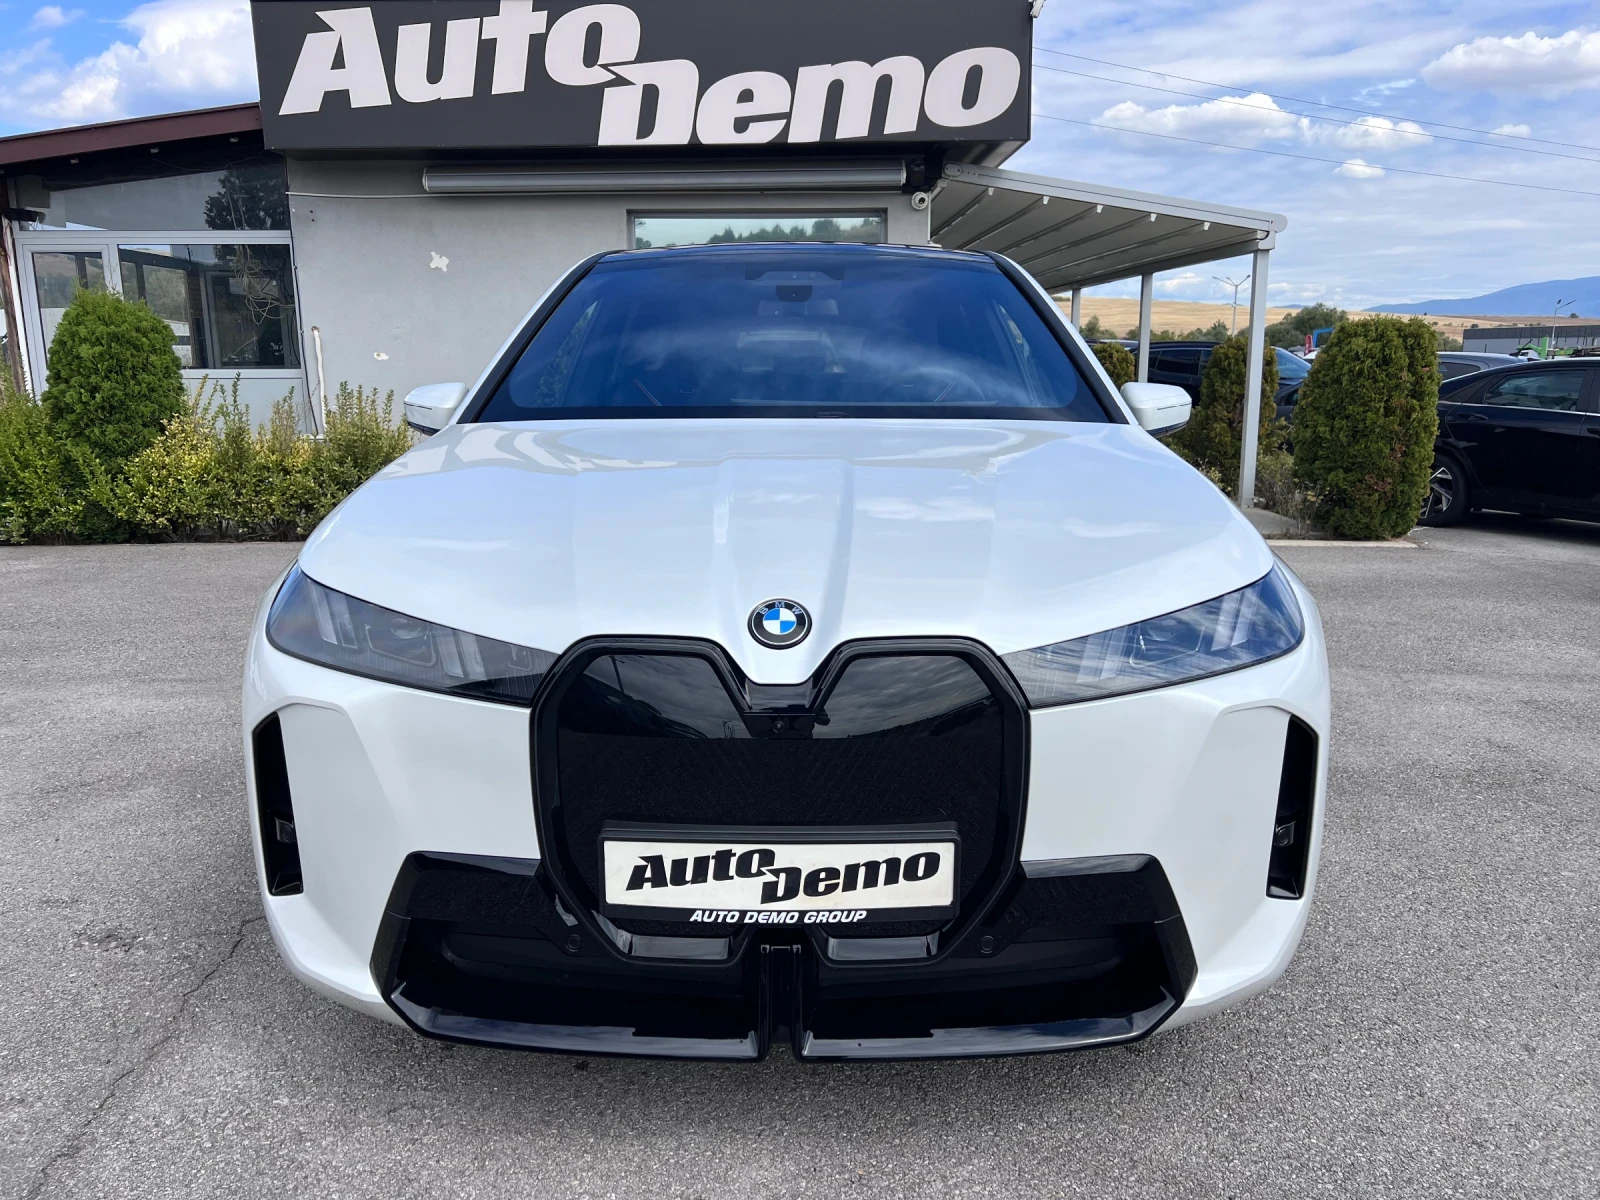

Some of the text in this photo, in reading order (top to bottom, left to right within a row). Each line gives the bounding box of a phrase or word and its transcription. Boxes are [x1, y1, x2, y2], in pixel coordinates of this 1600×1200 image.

[279, 0, 1020, 145] Auto Demo
[758, 600, 802, 615] BMW
[626, 848, 940, 904] Auto Demo
[690, 910, 867, 924] AUTO DEMO GROUP
